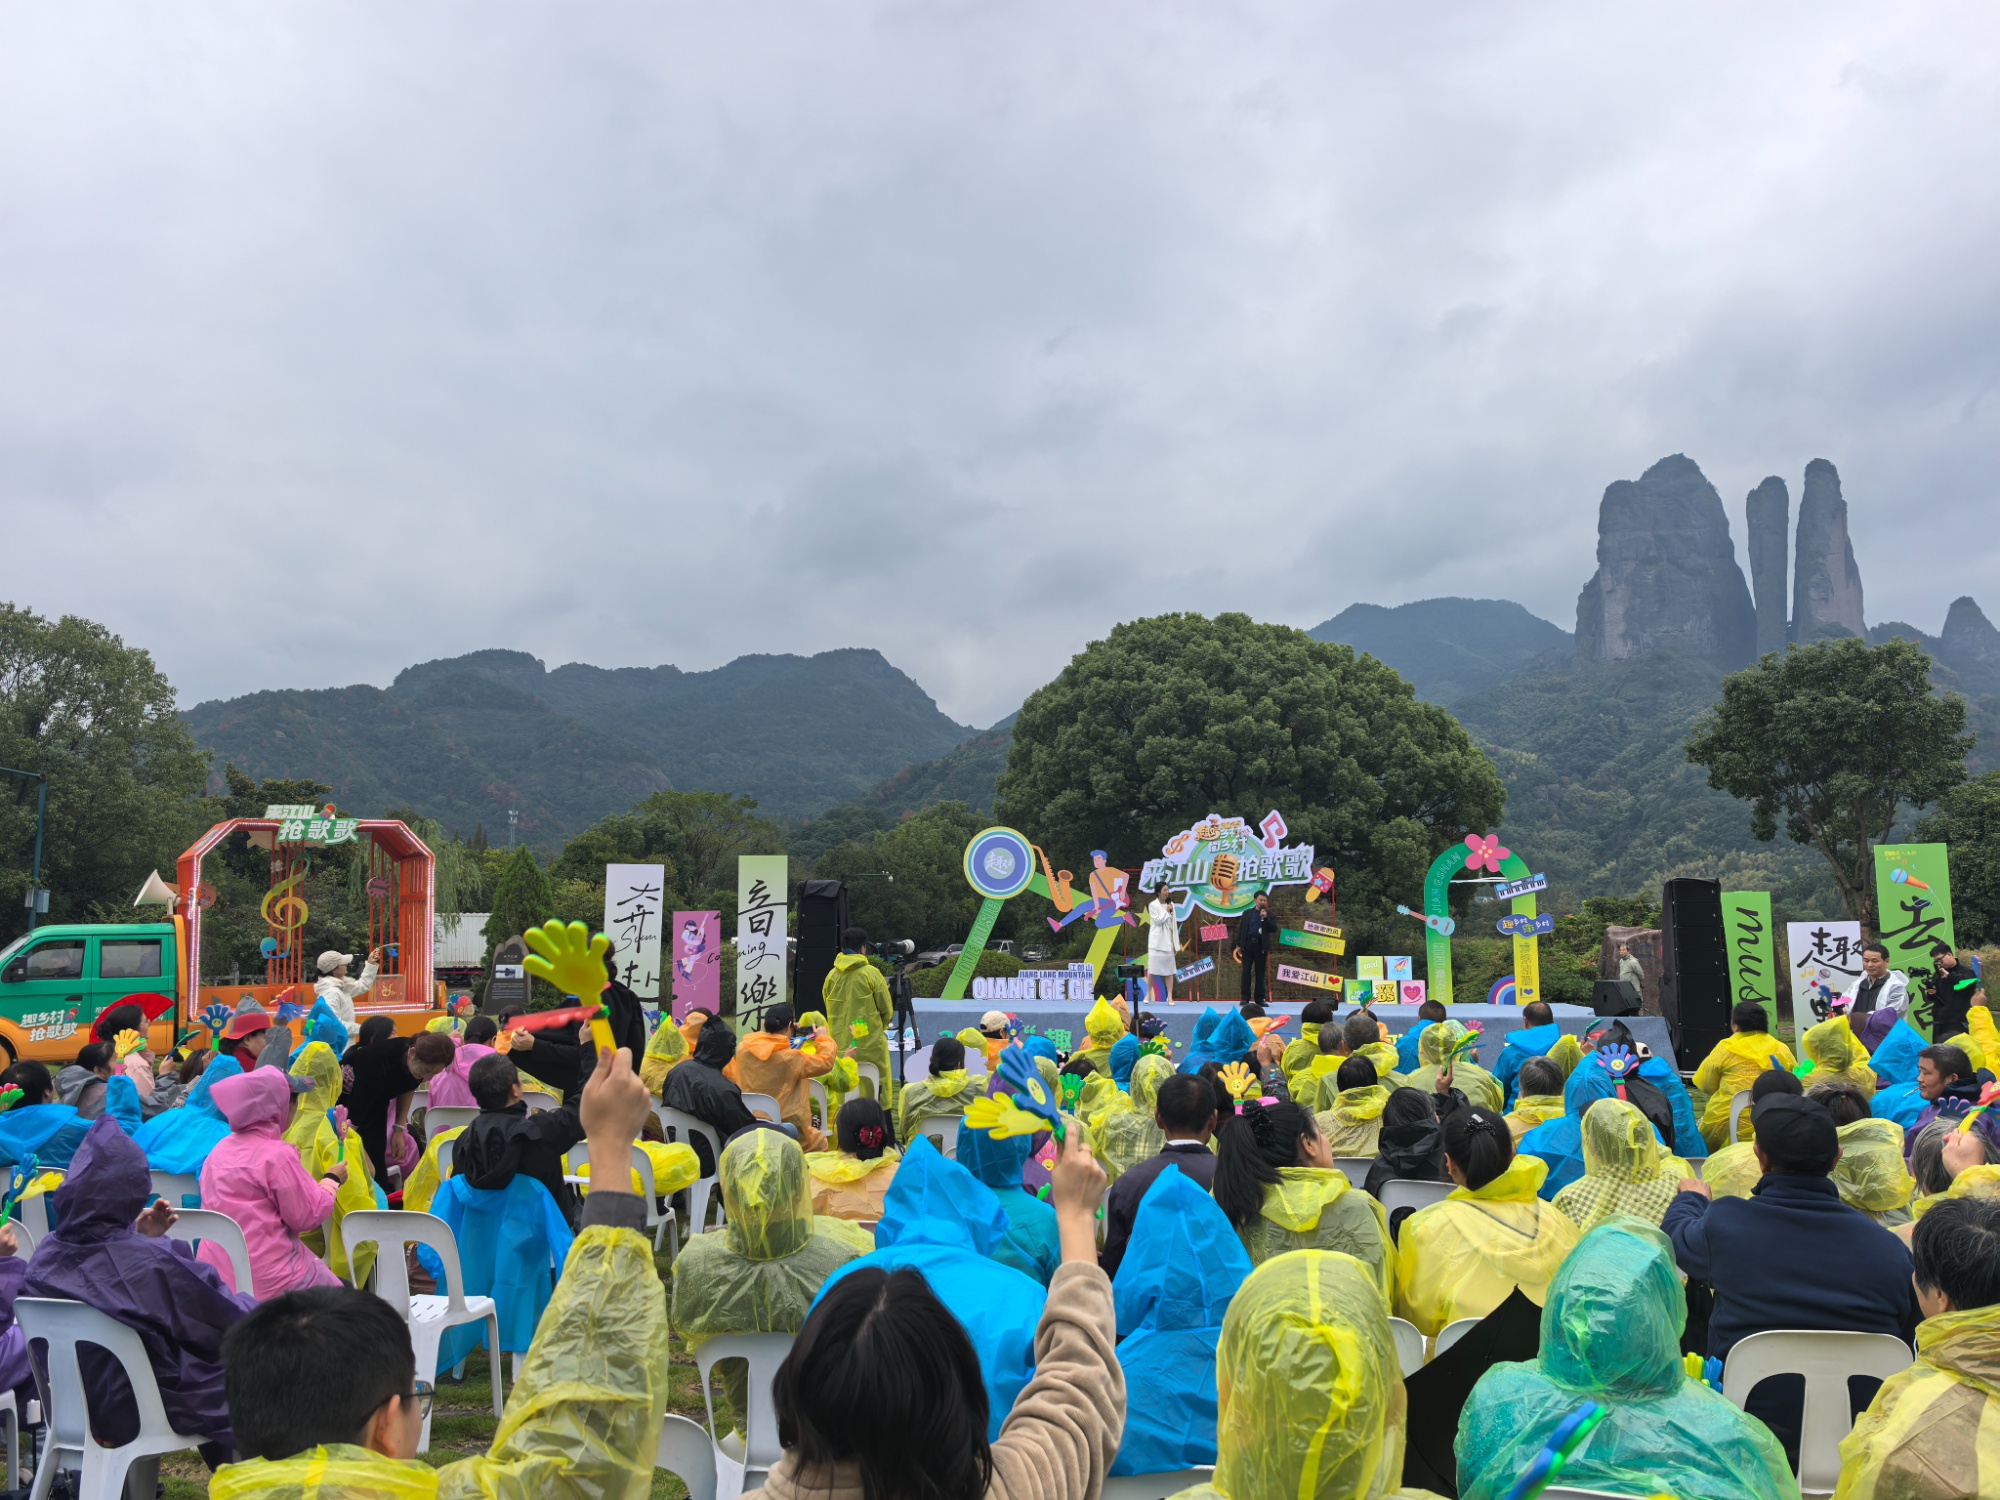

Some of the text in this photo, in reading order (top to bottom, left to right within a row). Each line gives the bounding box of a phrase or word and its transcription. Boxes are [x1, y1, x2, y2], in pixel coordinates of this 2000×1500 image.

[264, 804, 316, 819] 来江山
[279, 820, 358, 844] 抢歌歌
[1144, 859, 1209, 886] 来江山
[1238, 851, 1312, 881] 抢歌歌
[955, 900, 1000, 982] LOVE MUSIC
[1020, 970, 1093, 979] JIANG LANG MOUNTAIN
[1282, 968, 1319, 983] 我爱江山
[973, 977, 1095, 1000] QIANG GE GE
[20, 1009, 65, 1027] 趣乡村
[29, 1022, 79, 1043] 抢歌歌
